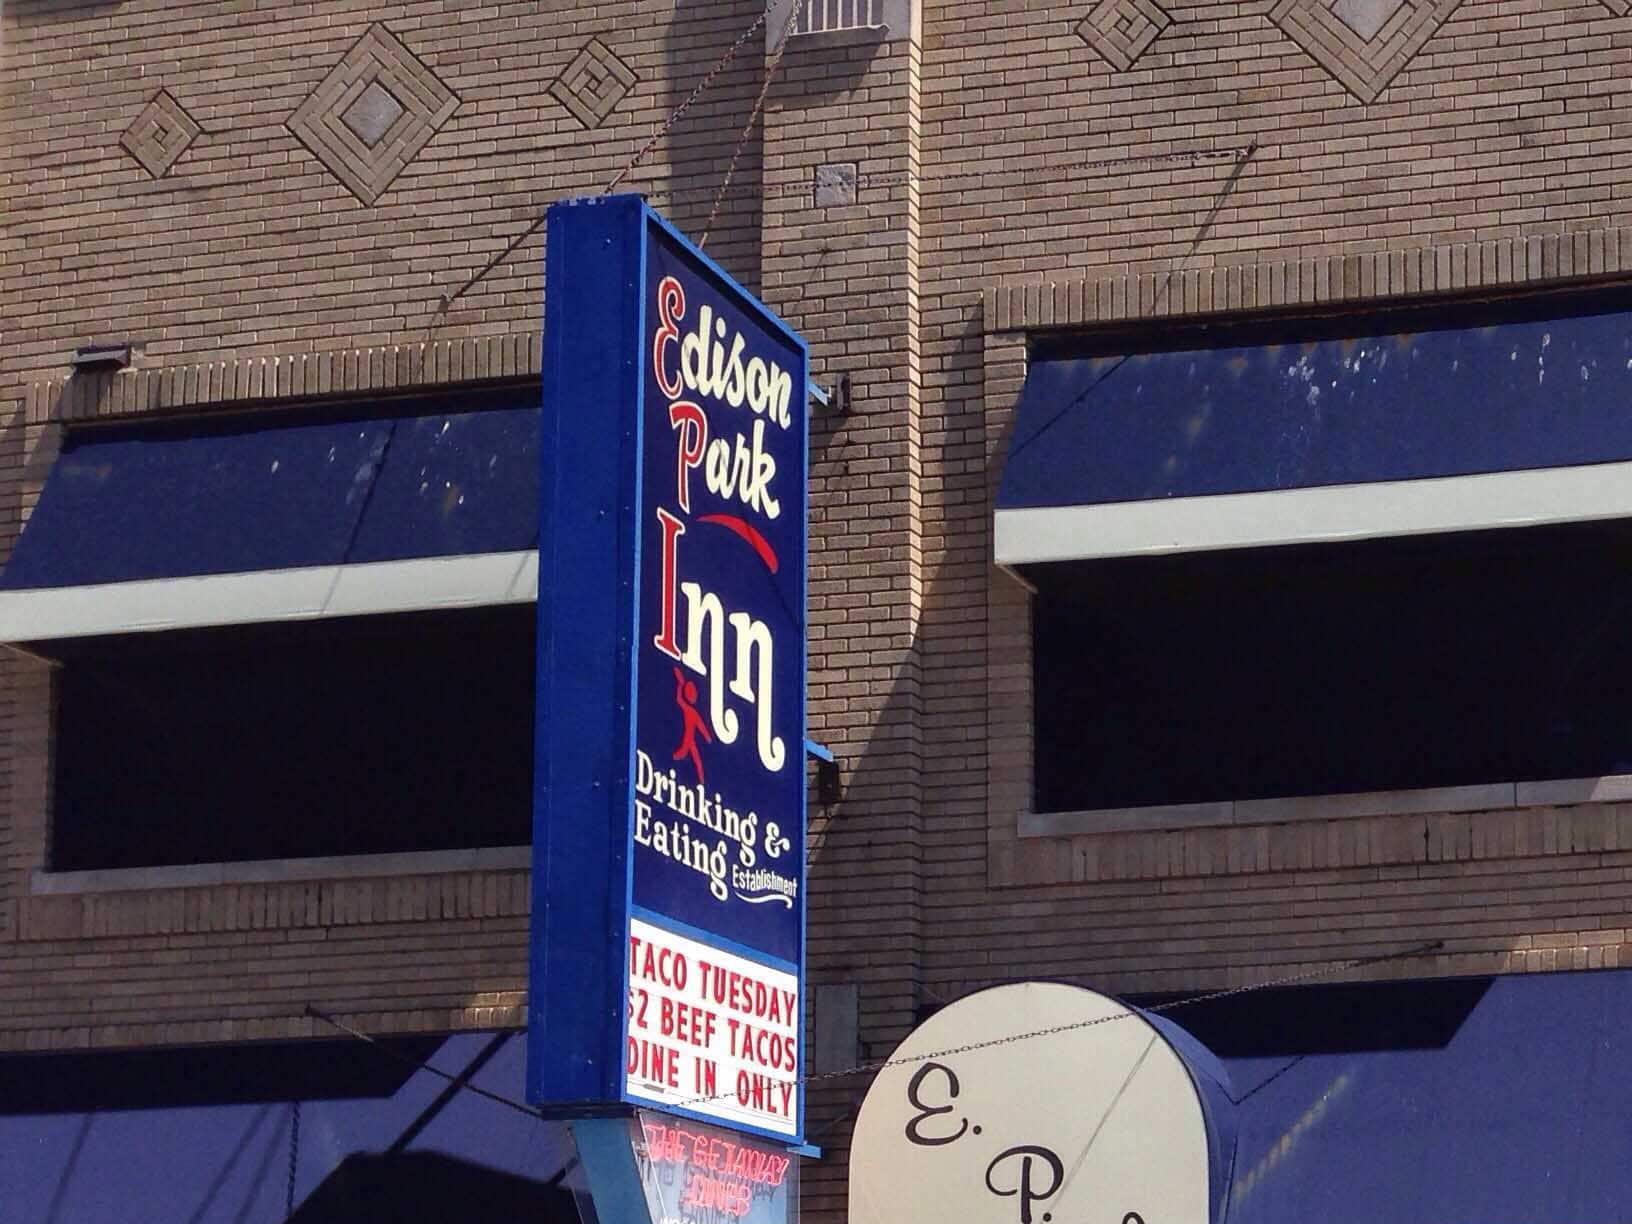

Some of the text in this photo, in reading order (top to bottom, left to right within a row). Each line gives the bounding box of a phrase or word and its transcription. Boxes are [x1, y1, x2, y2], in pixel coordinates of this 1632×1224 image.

[653, 276, 792, 429] Edison
[669, 401, 780, 519] Park
[654, 507, 785, 771] Inn
[633, 799, 797, 901] Eating Establishment
[636, 750, 790, 867] Drinking &
[630, 936, 796, 1027] TACO TUESDAY
[661, 997, 716, 1048] BEEF
[728, 1018, 796, 1072] TACOS
[628, 1036, 793, 1116] DINE IN ONLY
